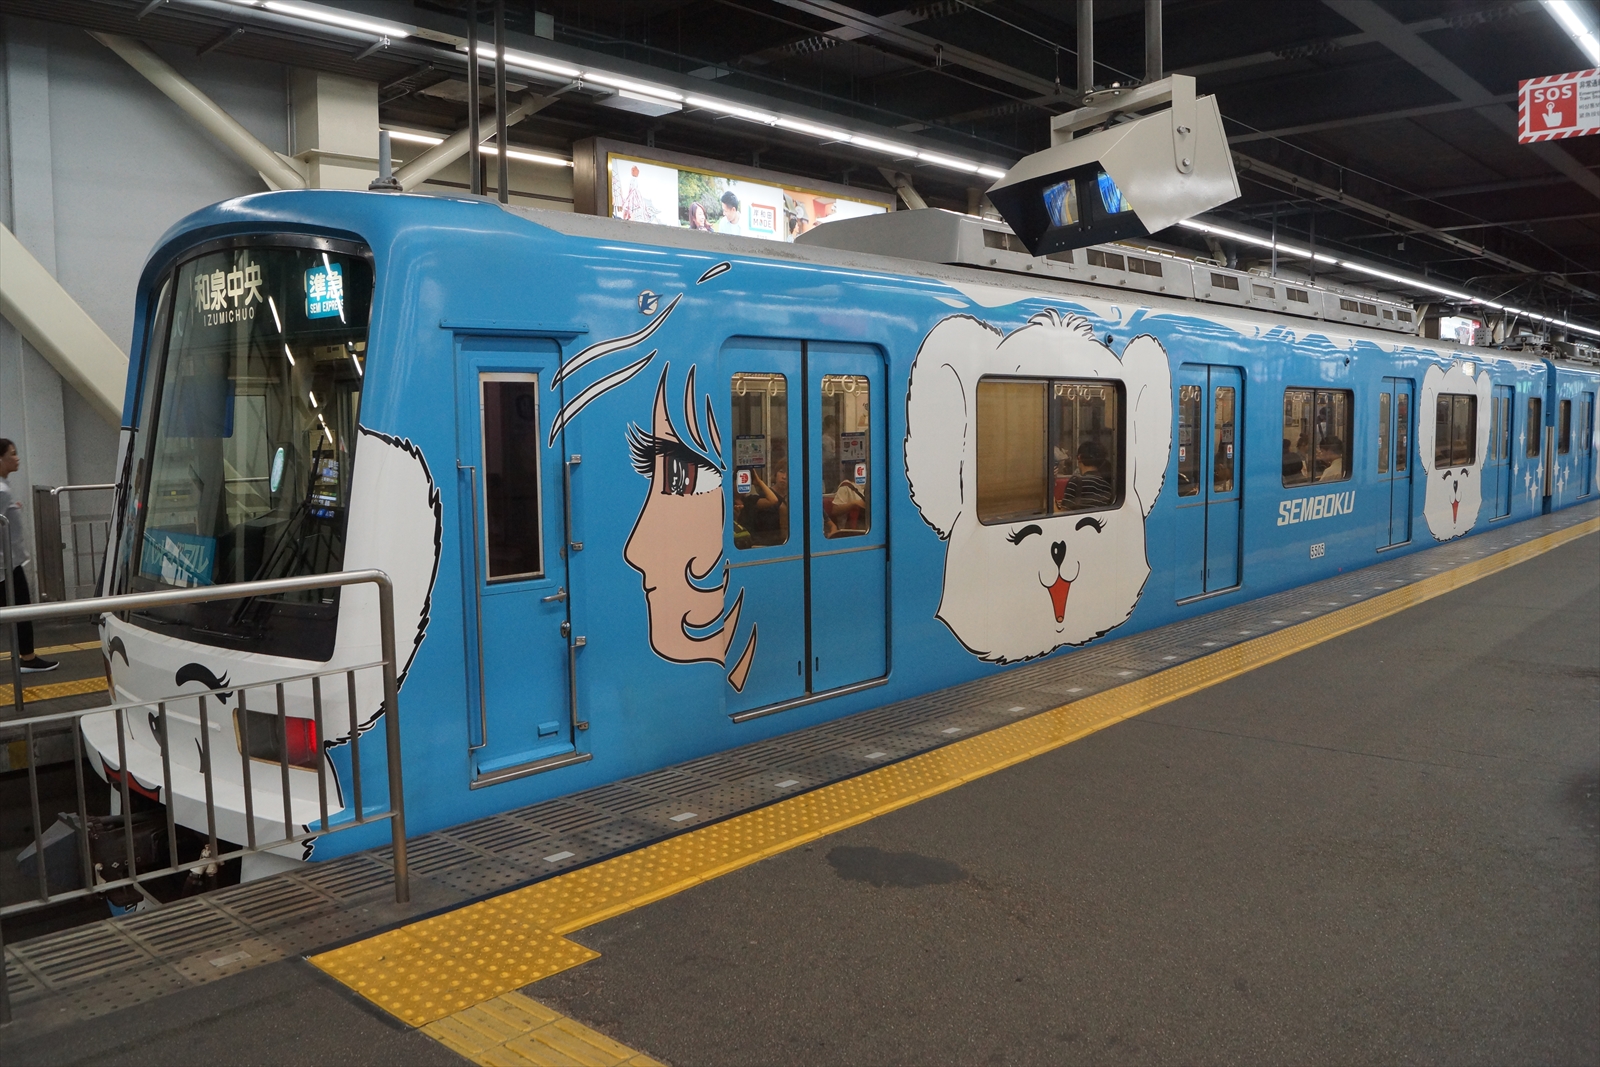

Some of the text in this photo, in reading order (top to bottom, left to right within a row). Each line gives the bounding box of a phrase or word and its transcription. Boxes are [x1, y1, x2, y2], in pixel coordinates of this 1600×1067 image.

[1534, 85, 1573, 103] SOS
[195, 261, 263, 312] 和泉中央
[309, 270, 343, 301] 準急
[203, 306, 255, 327] IZUMICHUO
[310, 302, 321, 314] SEMI
[1277, 490, 1356, 526] SEMBOKU
